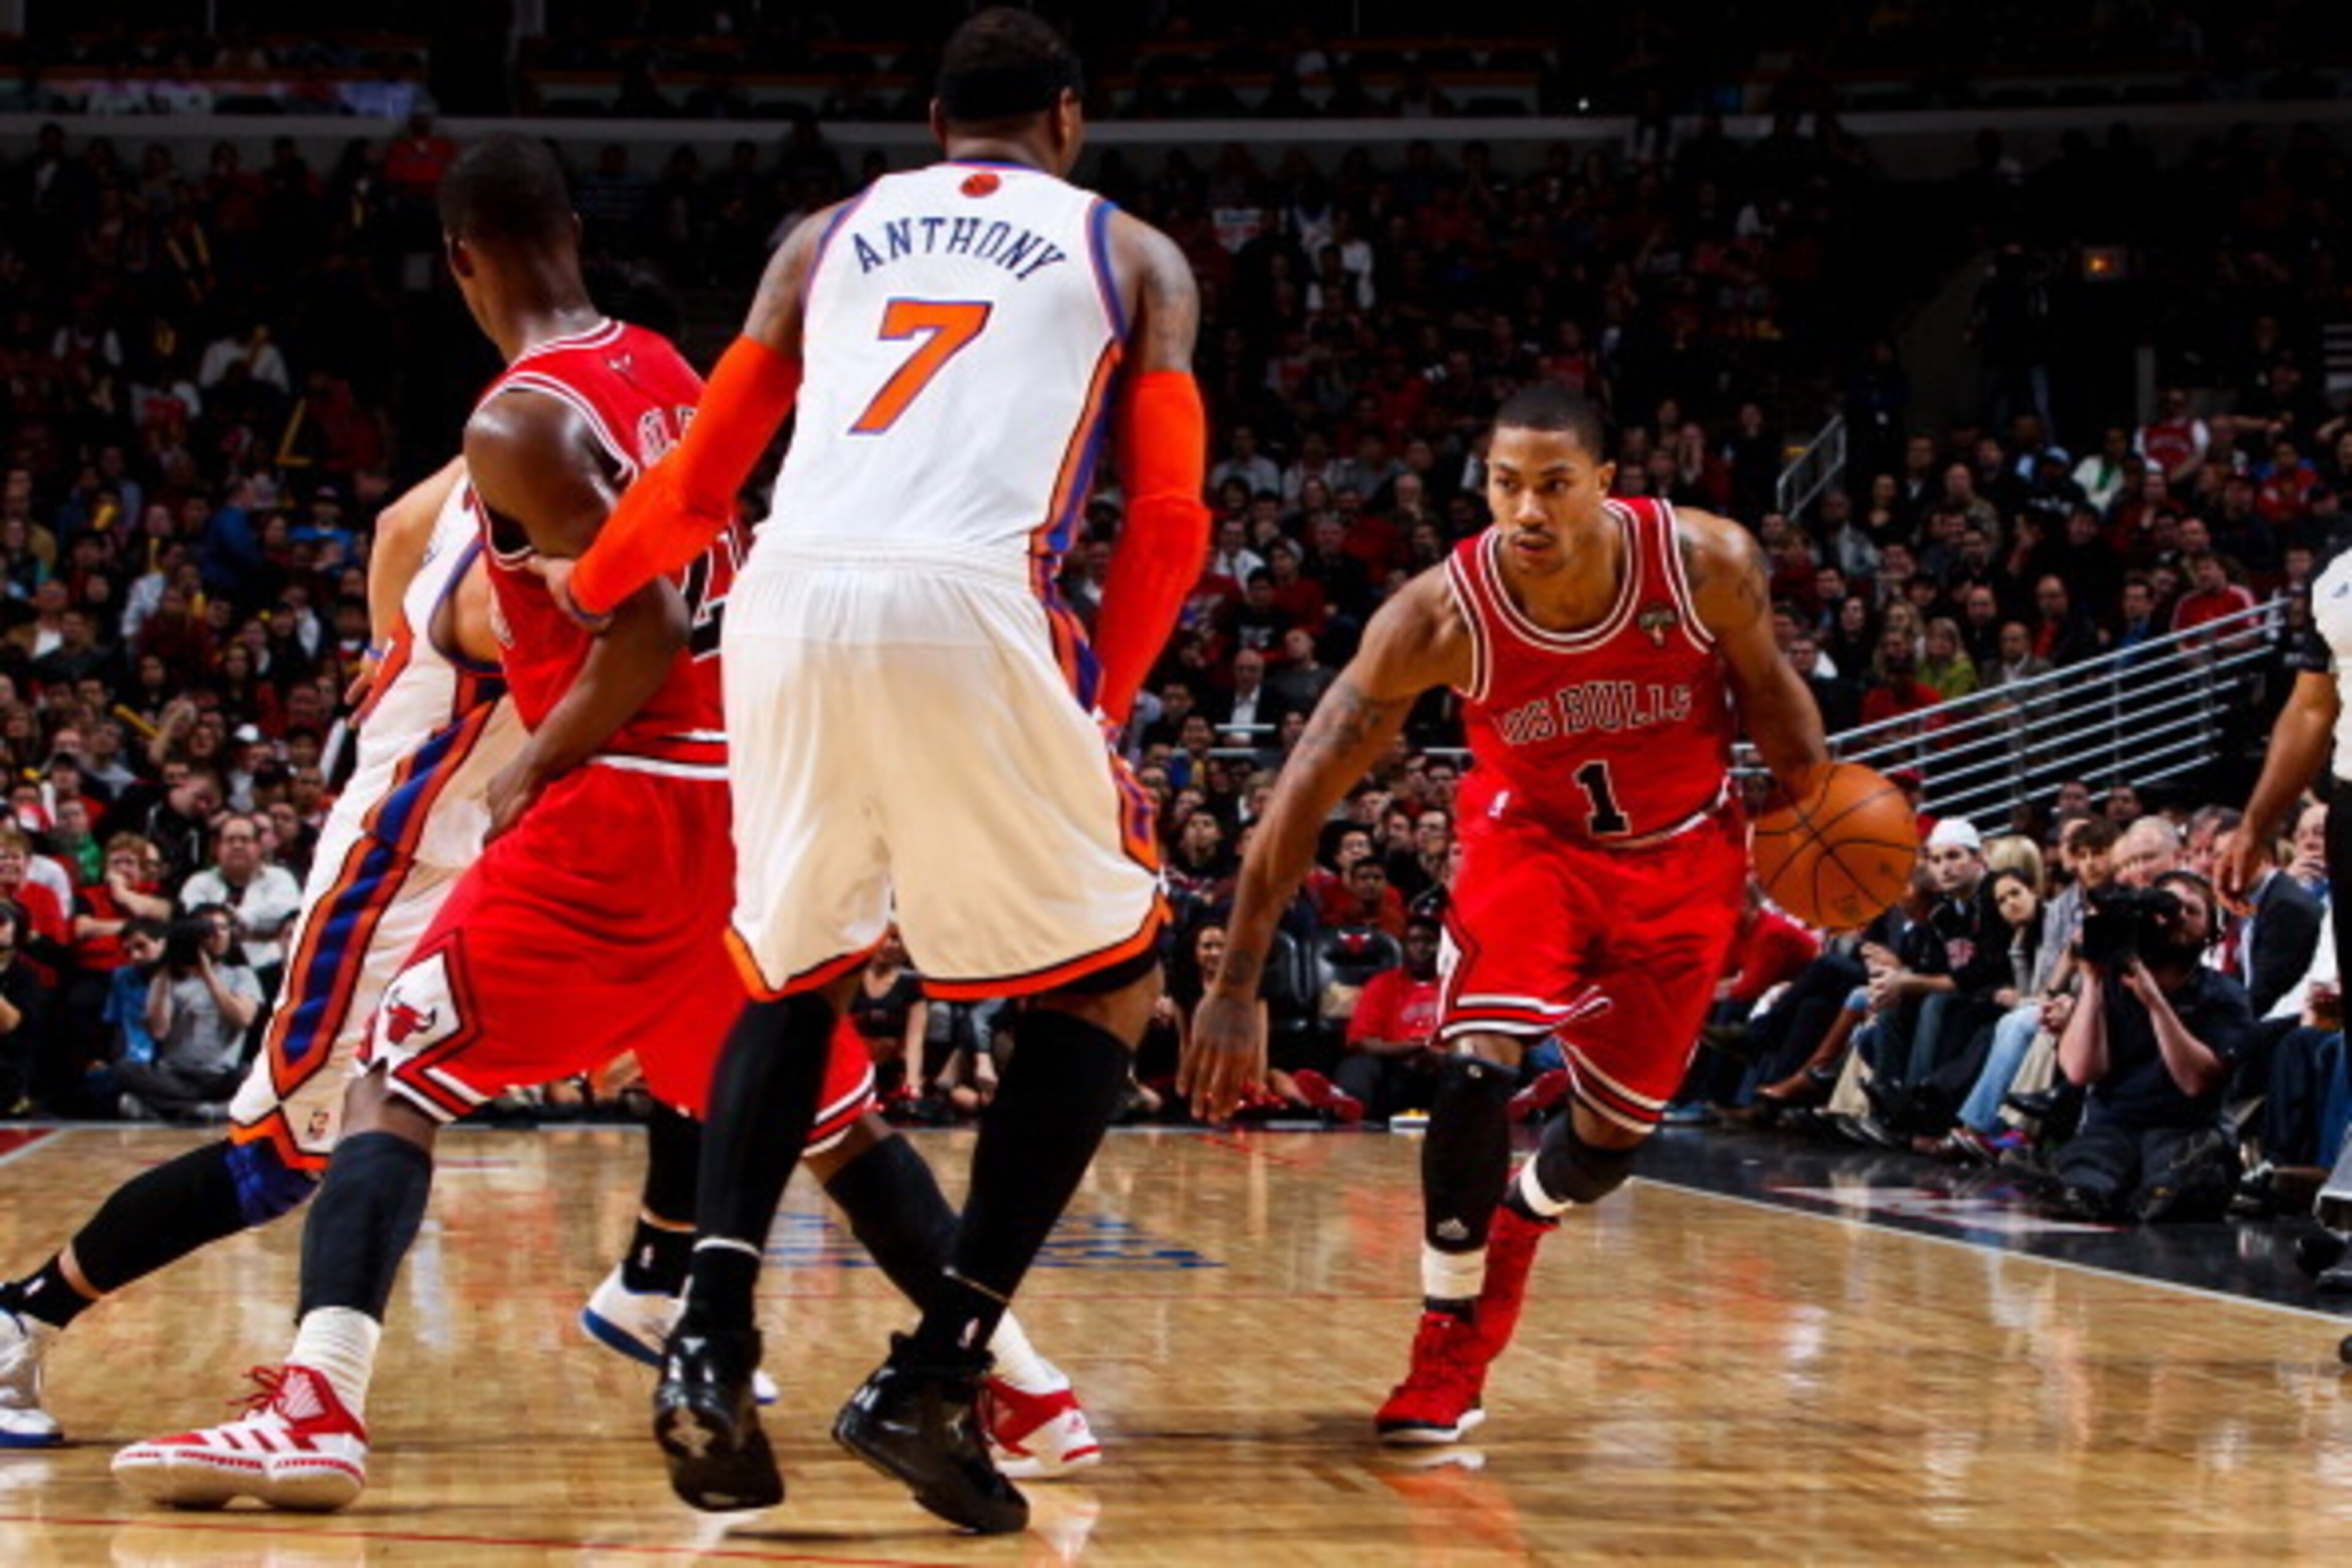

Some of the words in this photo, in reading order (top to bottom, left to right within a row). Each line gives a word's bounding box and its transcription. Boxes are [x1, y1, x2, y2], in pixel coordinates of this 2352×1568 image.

[853, 217, 1066, 281] ANTHONY
[847, 296, 993, 435] 7
[1555, 679, 1692, 737] BULLS
[1572, 760, 1632, 838] 1
